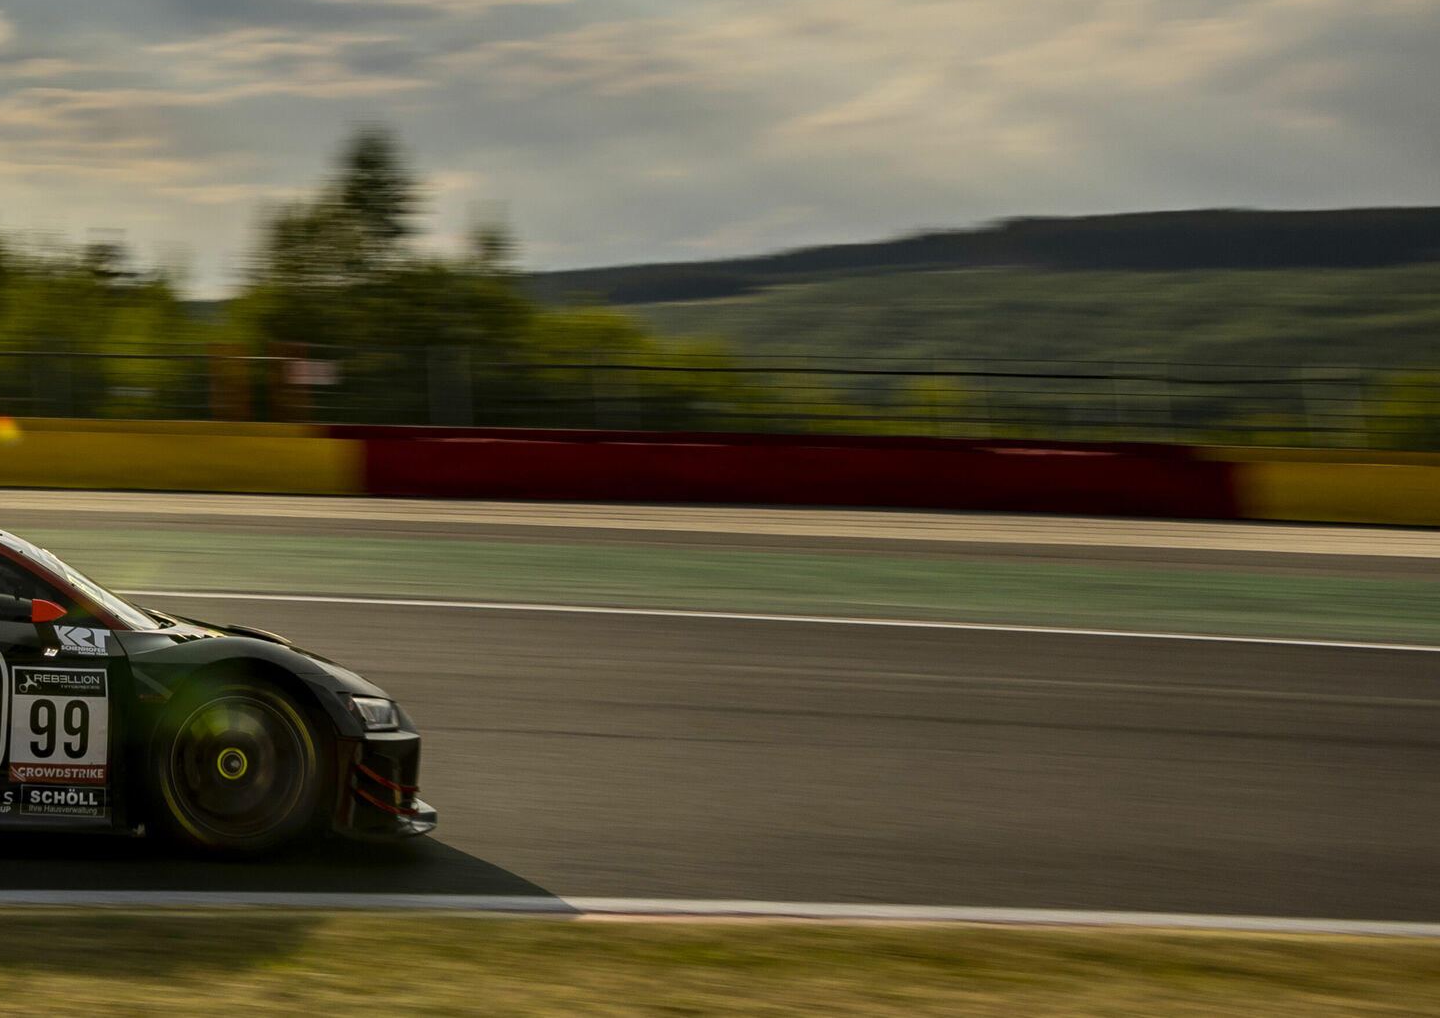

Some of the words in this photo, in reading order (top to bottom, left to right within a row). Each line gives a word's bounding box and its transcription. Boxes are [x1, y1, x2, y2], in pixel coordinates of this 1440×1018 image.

[53, 625, 111, 648] KRT
[34, 674, 100, 684] REBELLION
[30, 699, 89, 758] 99
[18, 767, 104, 779] CROWDSTRIKE
[30, 788, 99, 806] SCHÖLL
[44, 805, 98, 815] Hausverwaltung
